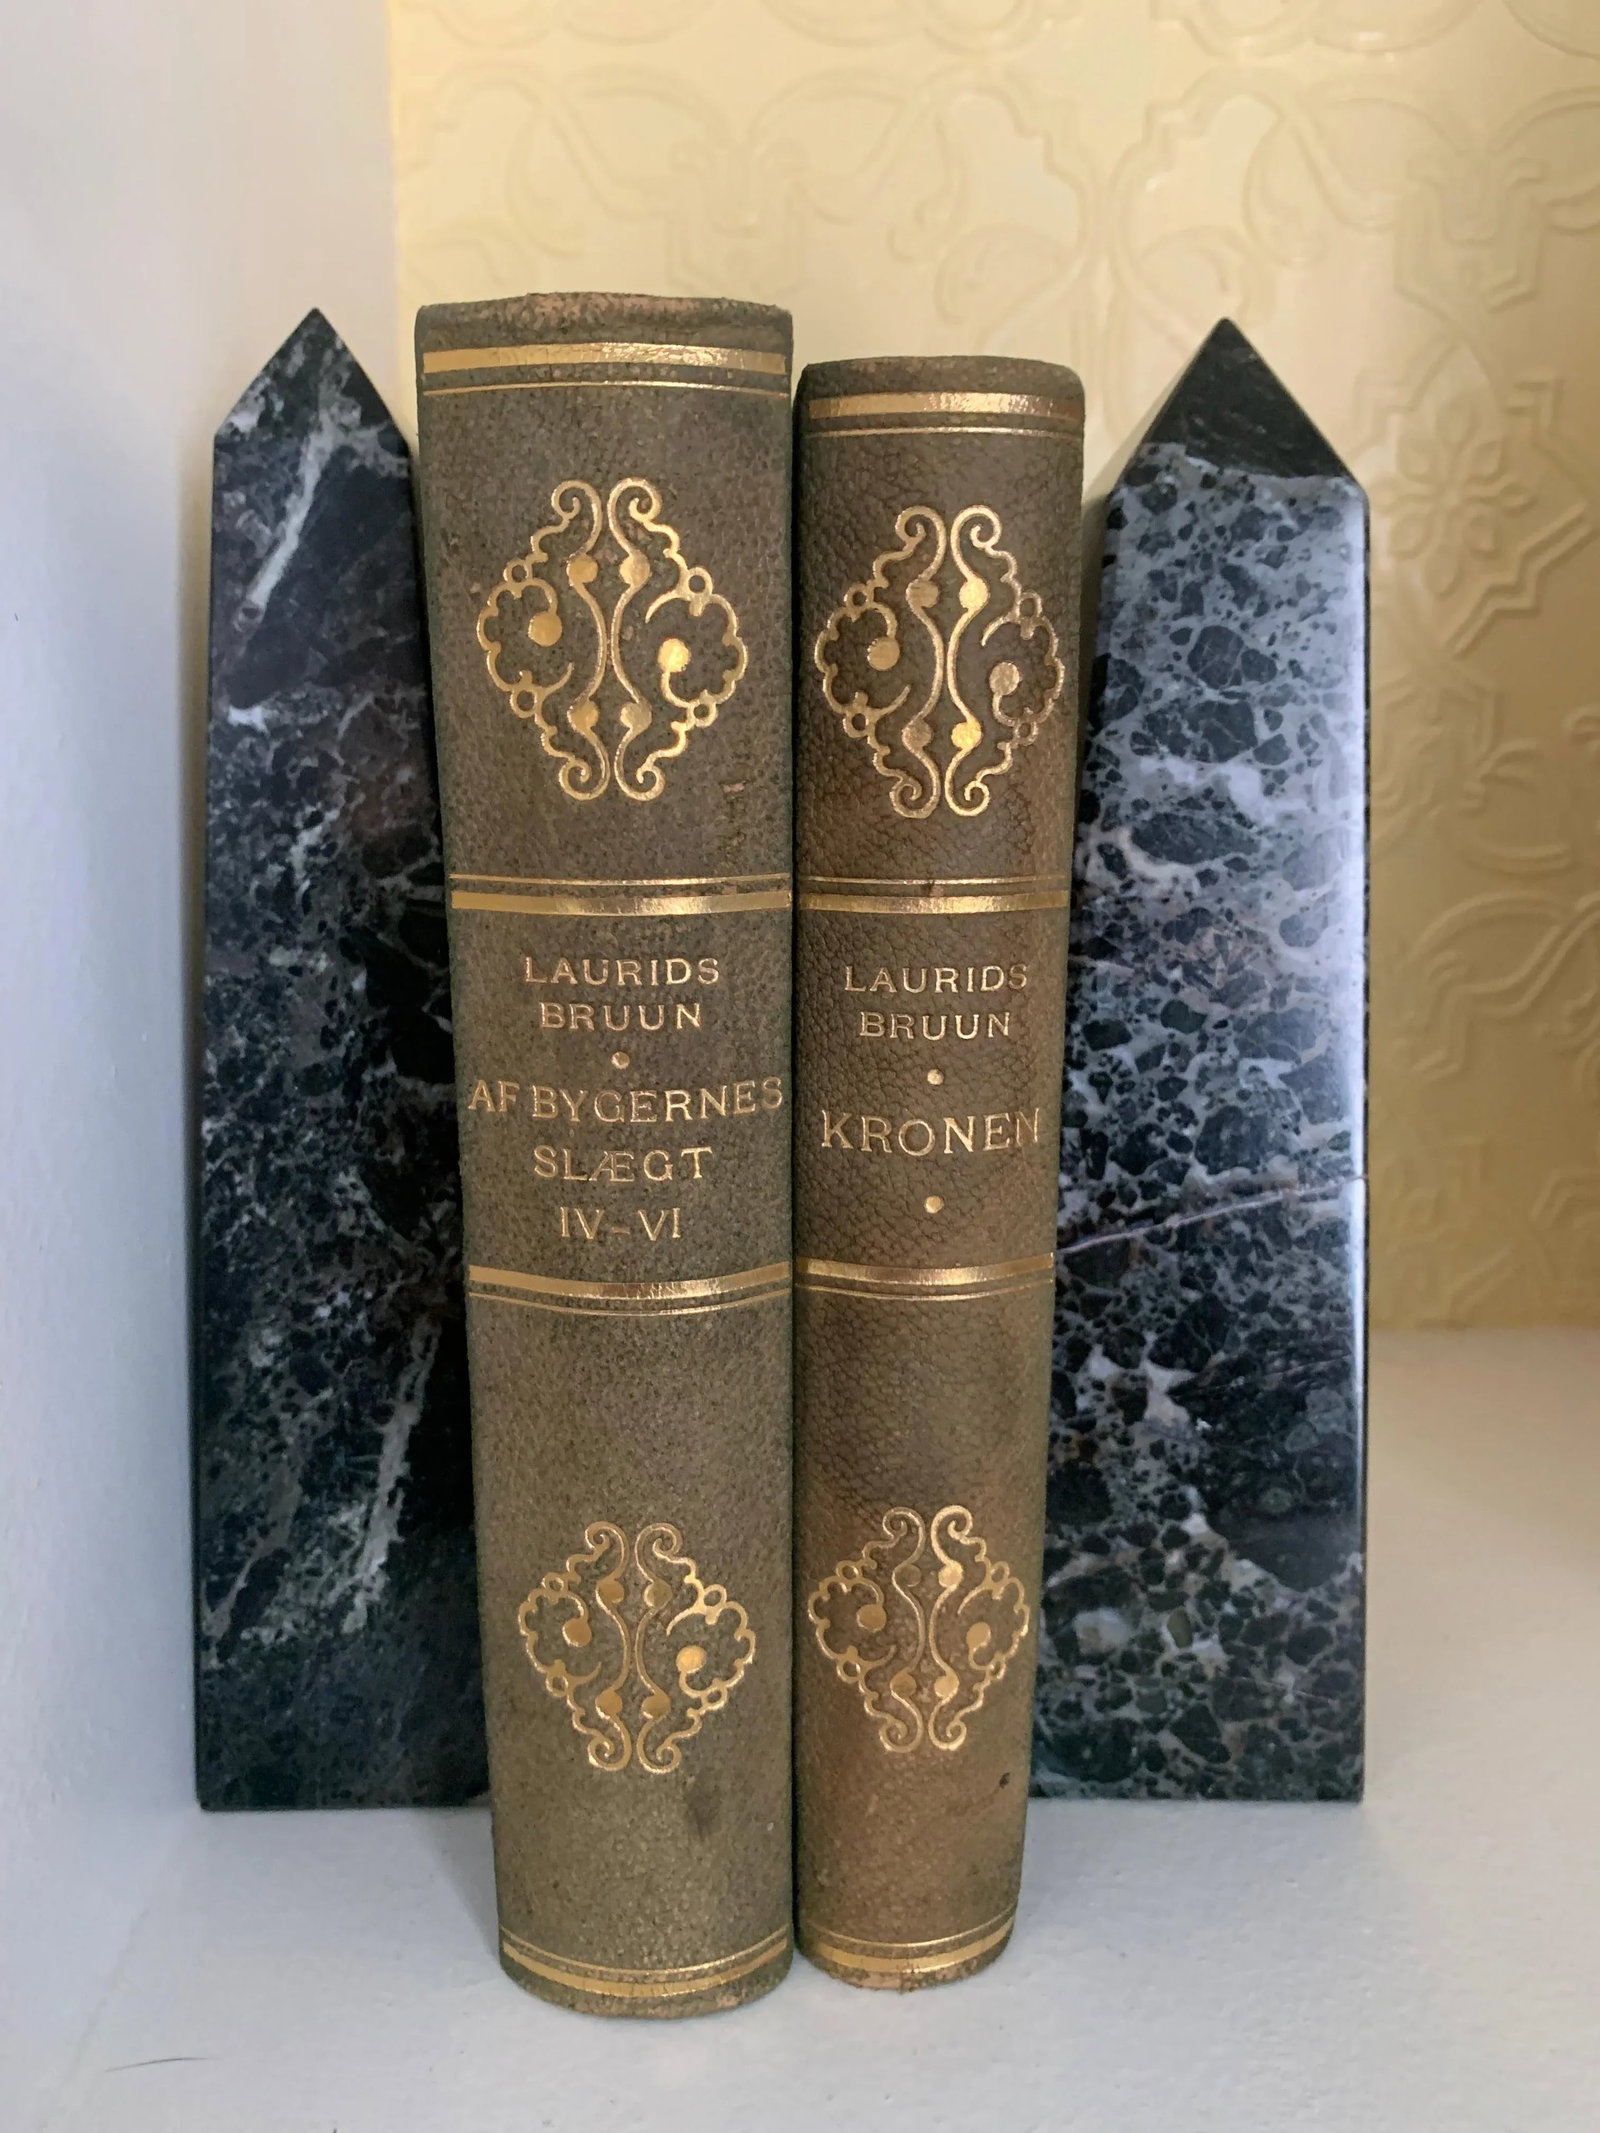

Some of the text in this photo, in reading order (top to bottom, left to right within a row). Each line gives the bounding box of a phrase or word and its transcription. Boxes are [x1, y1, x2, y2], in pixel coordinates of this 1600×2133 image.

[525, 956, 720, 986] LAURIDS
[844, 963, 1029, 993] LAURIDS
[539, 1001, 701, 1031] BRUUN
[859, 1011, 1011, 1041] BRUUN
[467, 1076, 783, 1123] AF BYGERNES
[820, 1107, 1040, 1157] KRONEN
[533, 1144, 714, 1182] SLÆGT
